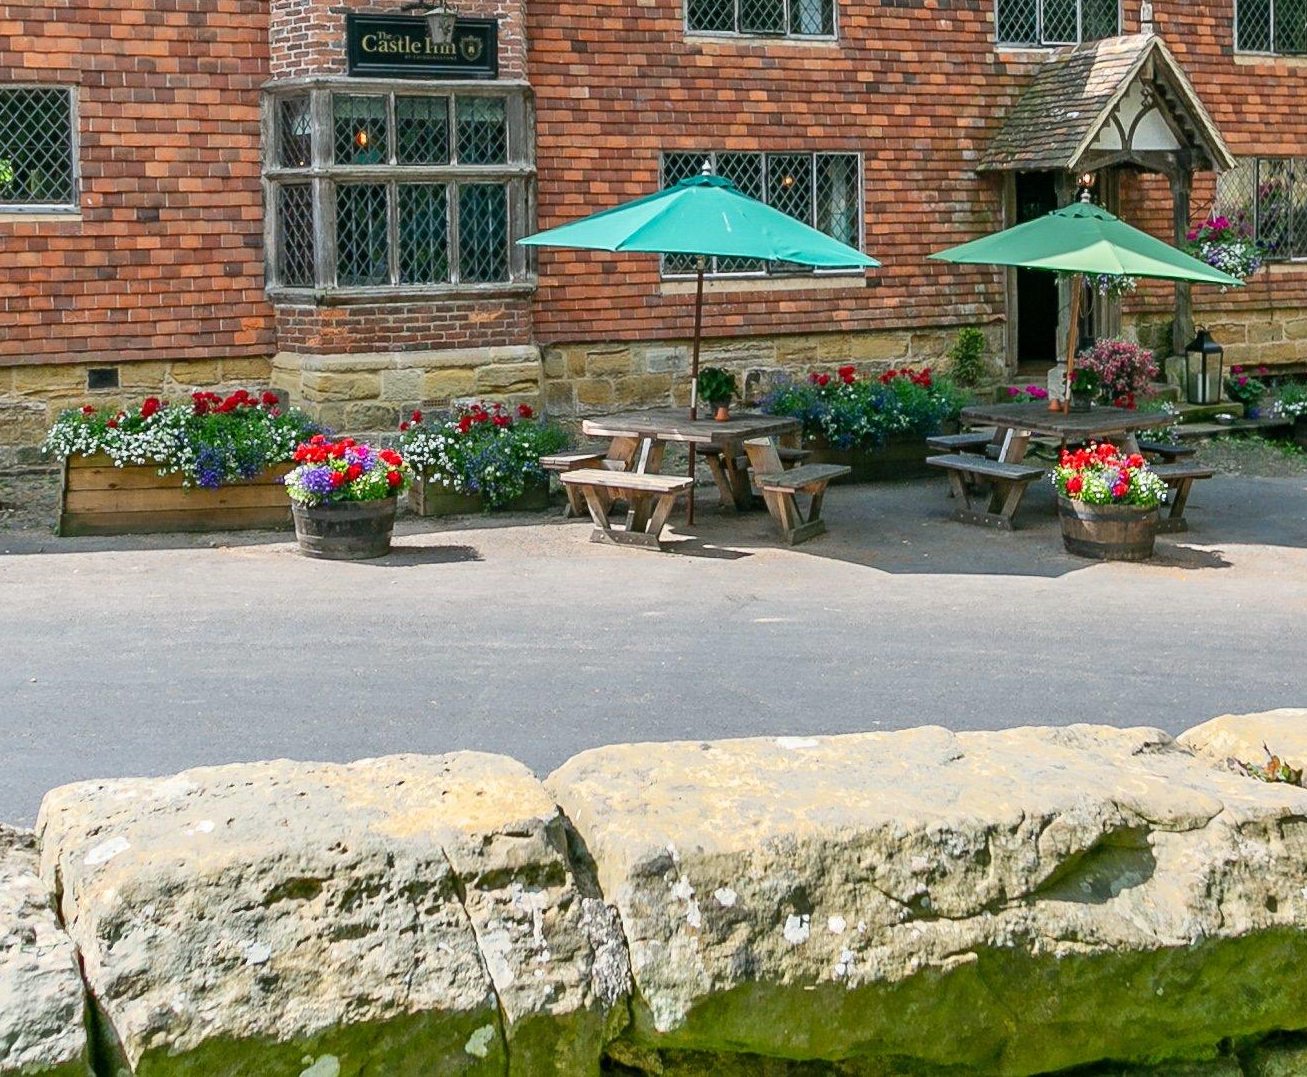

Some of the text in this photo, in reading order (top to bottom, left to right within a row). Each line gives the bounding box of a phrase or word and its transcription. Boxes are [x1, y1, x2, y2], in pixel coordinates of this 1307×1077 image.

[376, 31, 393, 40] The
[361, 34, 457, 54] Castle Inn
